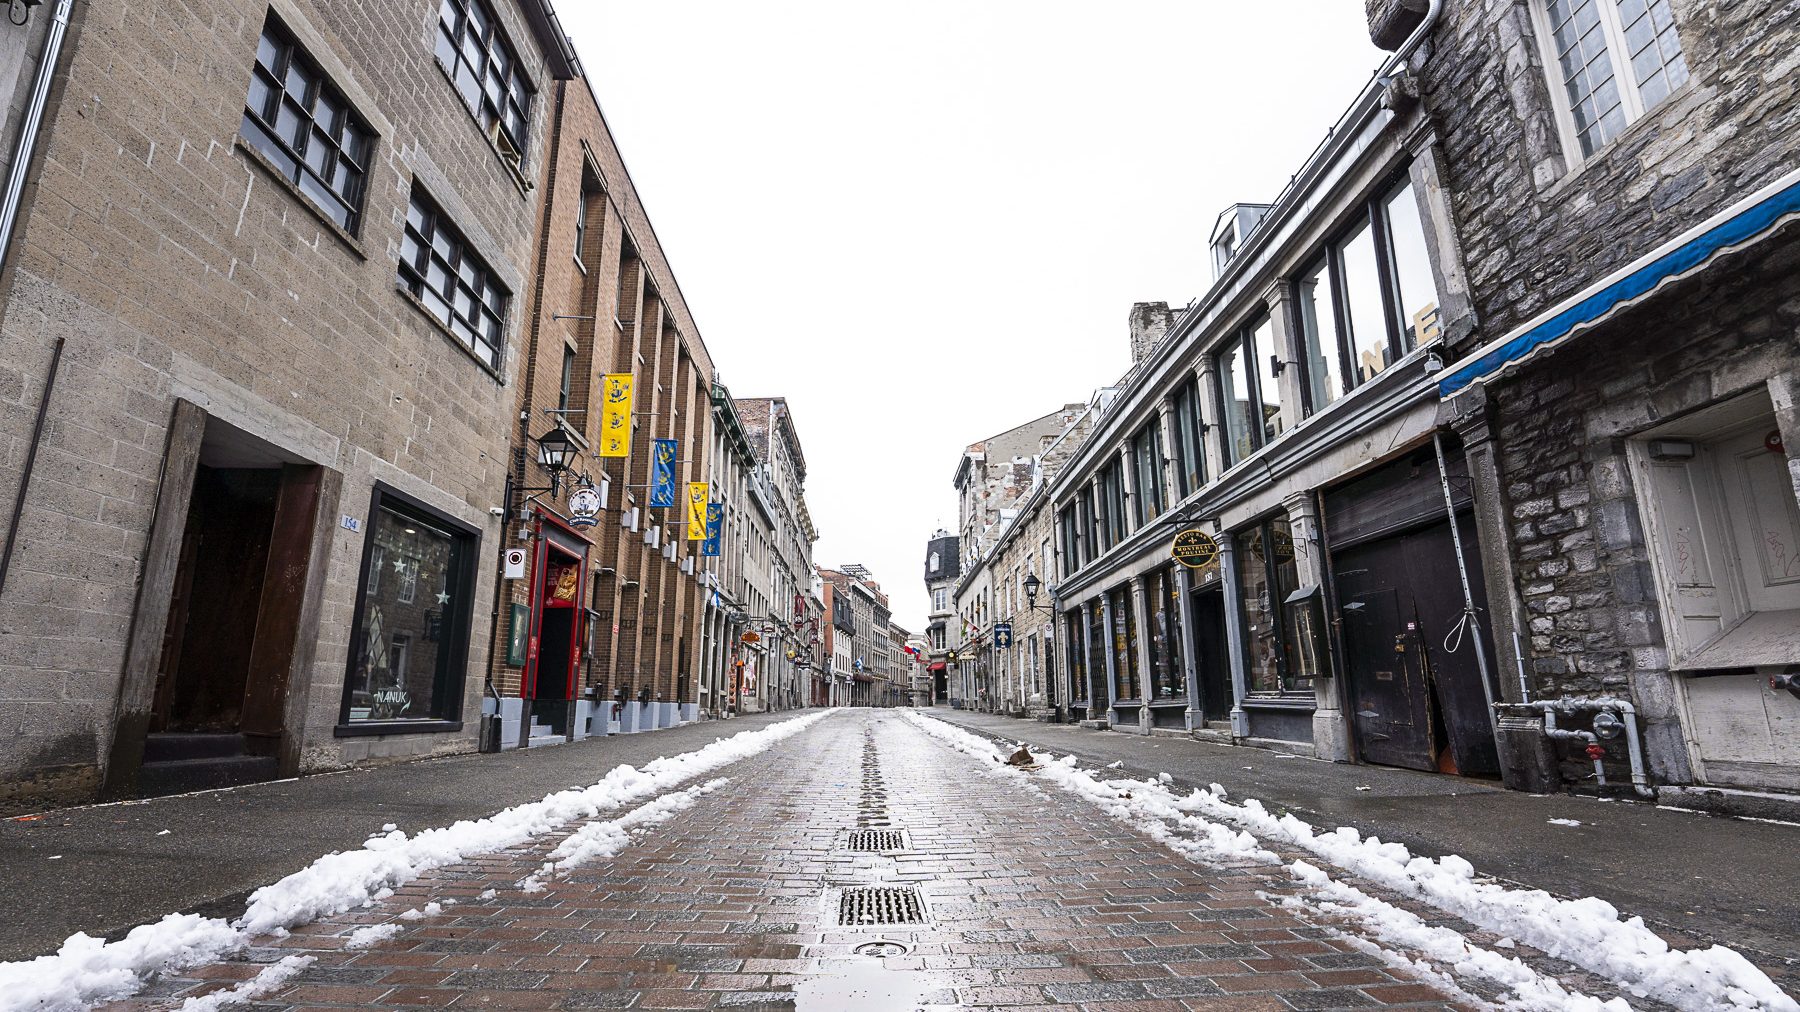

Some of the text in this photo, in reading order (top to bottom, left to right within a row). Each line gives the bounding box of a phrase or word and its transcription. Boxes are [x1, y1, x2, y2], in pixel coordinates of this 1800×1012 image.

[345, 517, 357, 529] 154
[1177, 532, 1207, 543] RESTO BAR
[375, 690, 407, 703] NANUK
